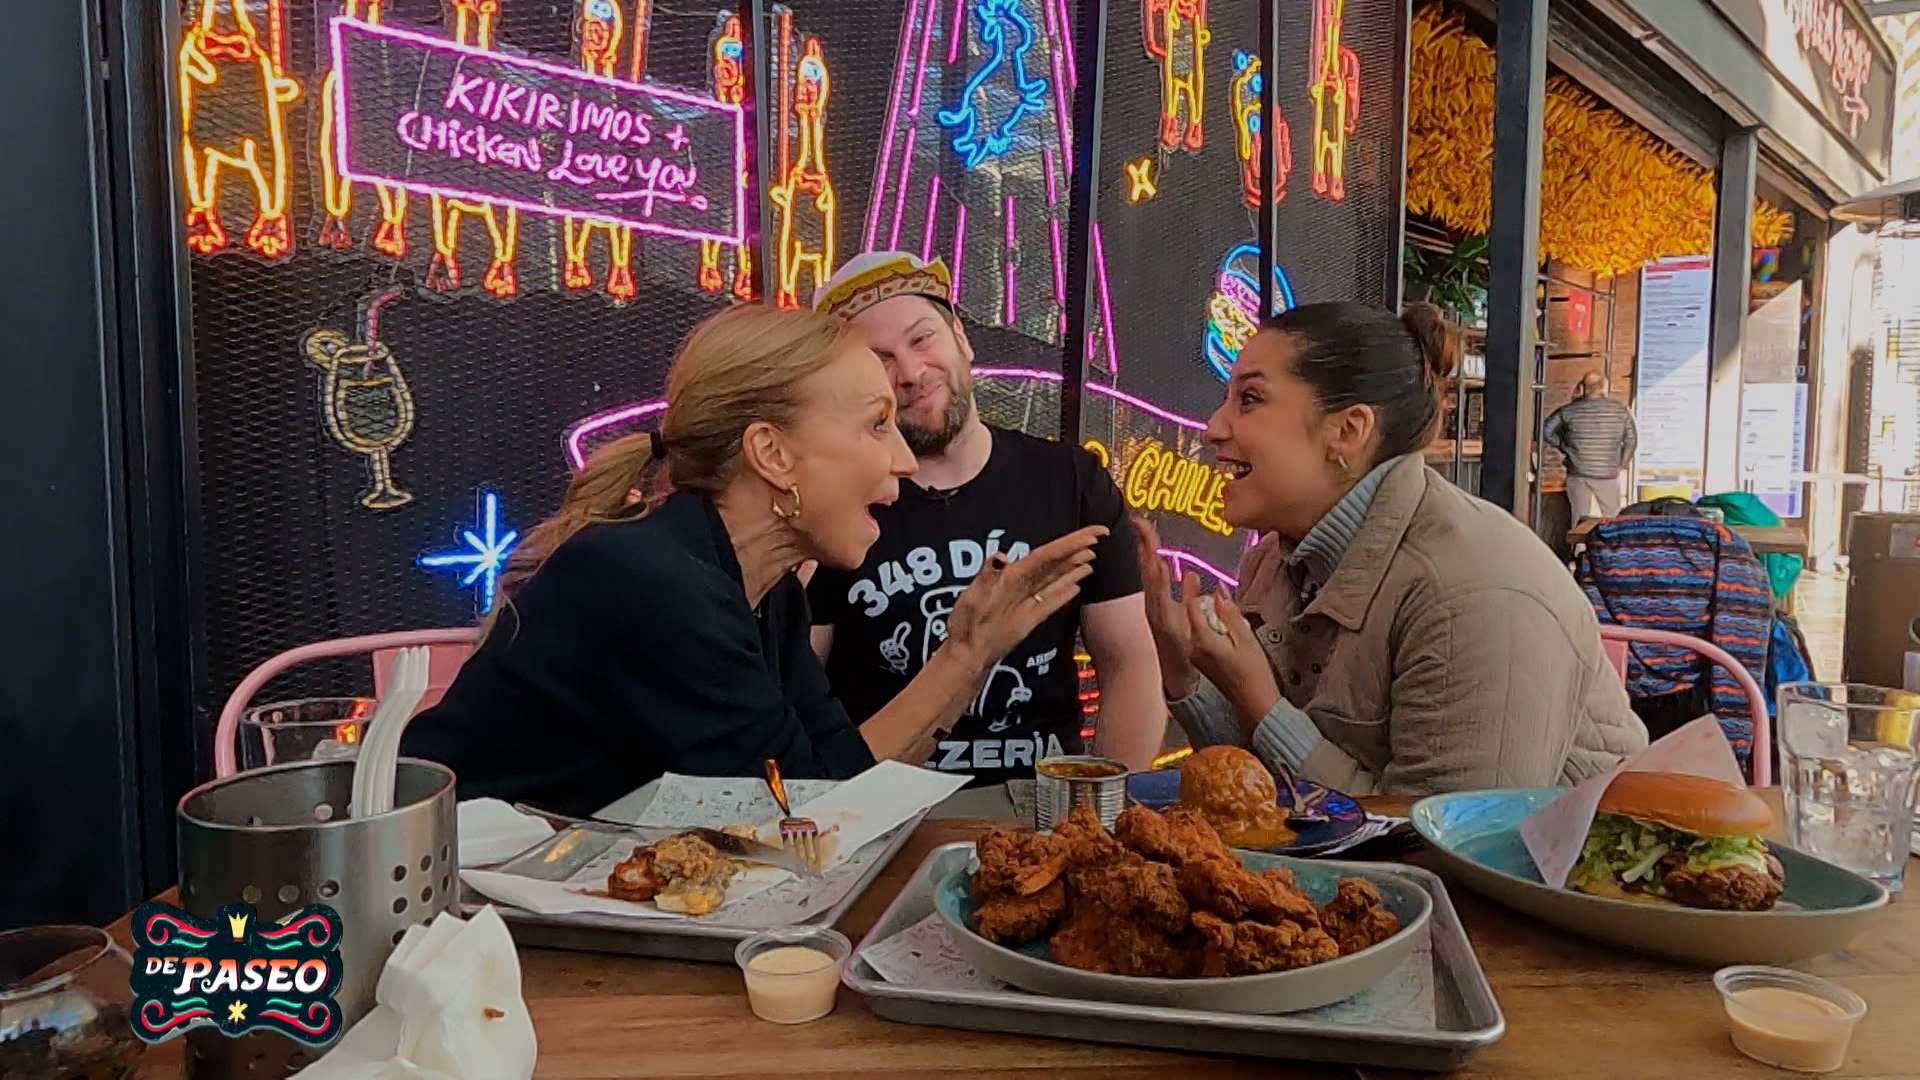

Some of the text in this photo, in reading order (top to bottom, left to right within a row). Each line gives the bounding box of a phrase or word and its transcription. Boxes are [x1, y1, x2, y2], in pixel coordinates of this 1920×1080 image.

[445, 72, 653, 145] KIKIRIMOS
[847, 528, 1031, 618] 348 DÍA
[926, 730, 1065, 769] ZERÍA
